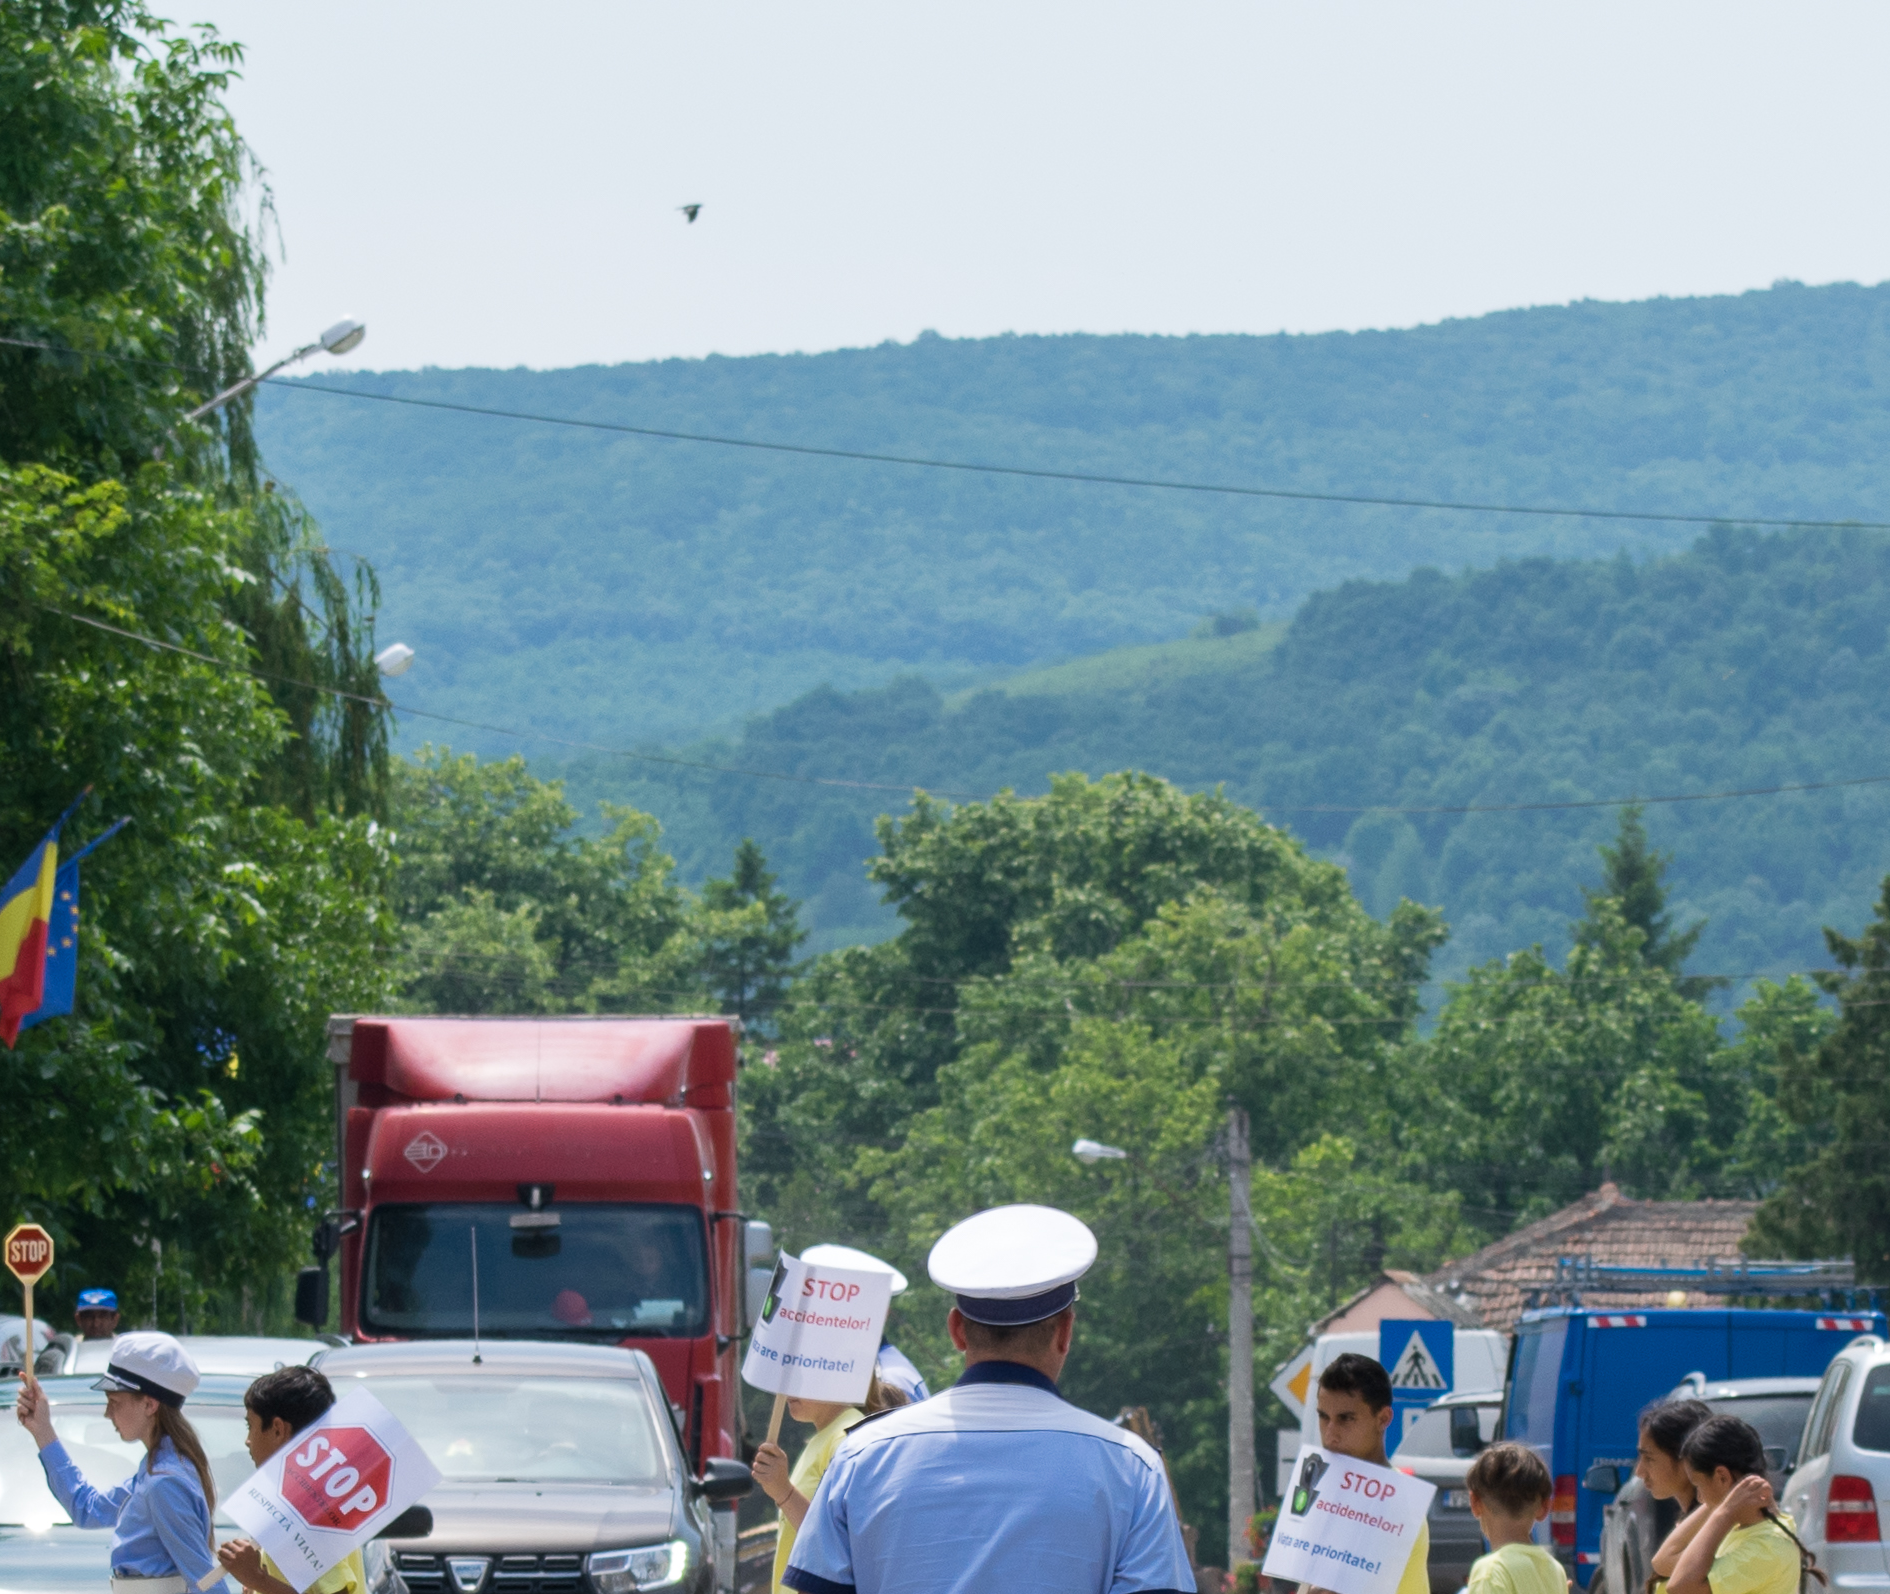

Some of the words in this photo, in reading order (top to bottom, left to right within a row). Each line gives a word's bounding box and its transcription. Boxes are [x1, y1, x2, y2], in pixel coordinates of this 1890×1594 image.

[11, 1240, 47, 1263] STOP
[802, 1277, 860, 1303] STOP
[779, 1307, 871, 1331] accidentelor!
[760, 1345, 779, 1361] are
[781, 1353, 855, 1373] prioritate!
[295, 1436, 377, 1515] STOP
[1340, 1471, 1396, 1501] STOP
[248, 1487, 295, 1532] RESPECTĂ
[1316, 1500, 1404, 1536] accidentelor!
[1293, 1537, 1310, 1551] are
[1311, 1543, 1382, 1574] prioritate!
